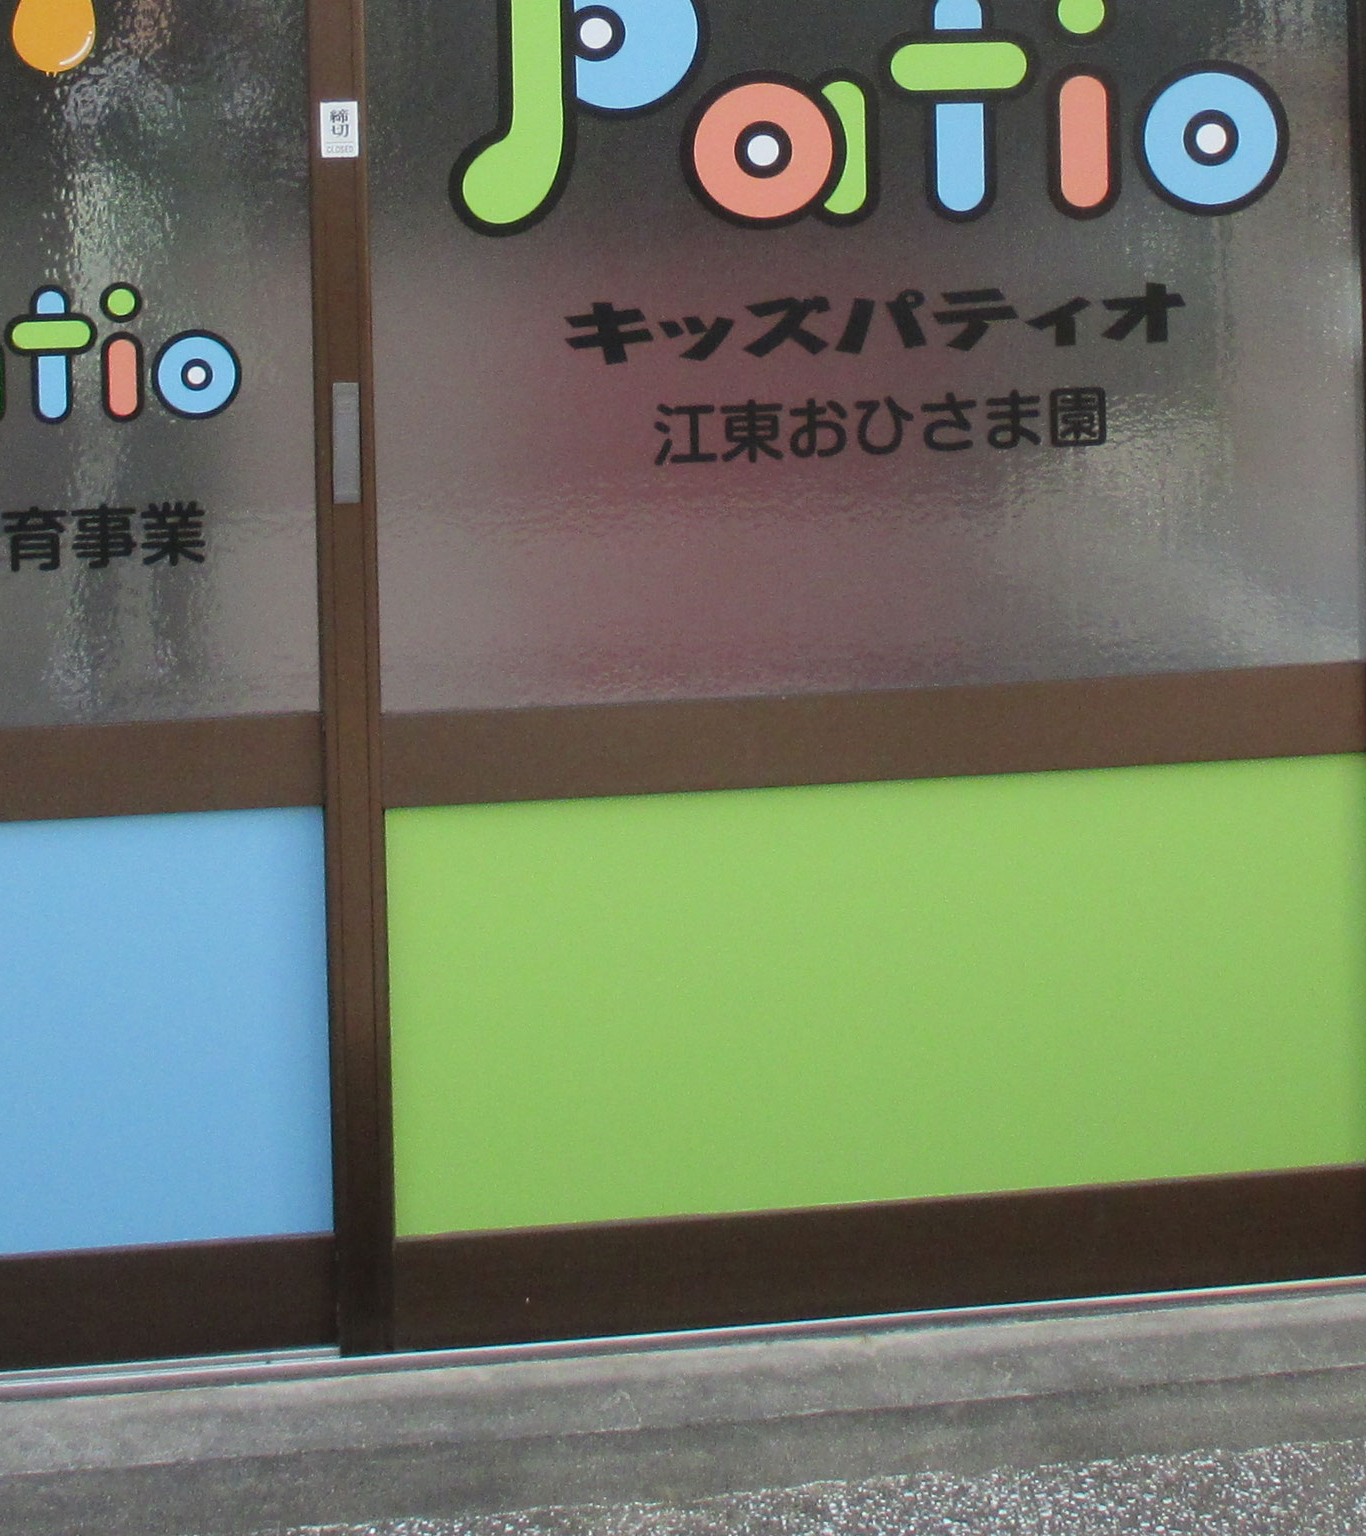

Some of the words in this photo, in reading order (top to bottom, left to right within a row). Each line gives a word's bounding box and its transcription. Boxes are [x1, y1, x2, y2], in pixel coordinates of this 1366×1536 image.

[564, 281, 1187, 365] キッズパティオ
[653, 386, 1108, 467] 江東おひさま園
